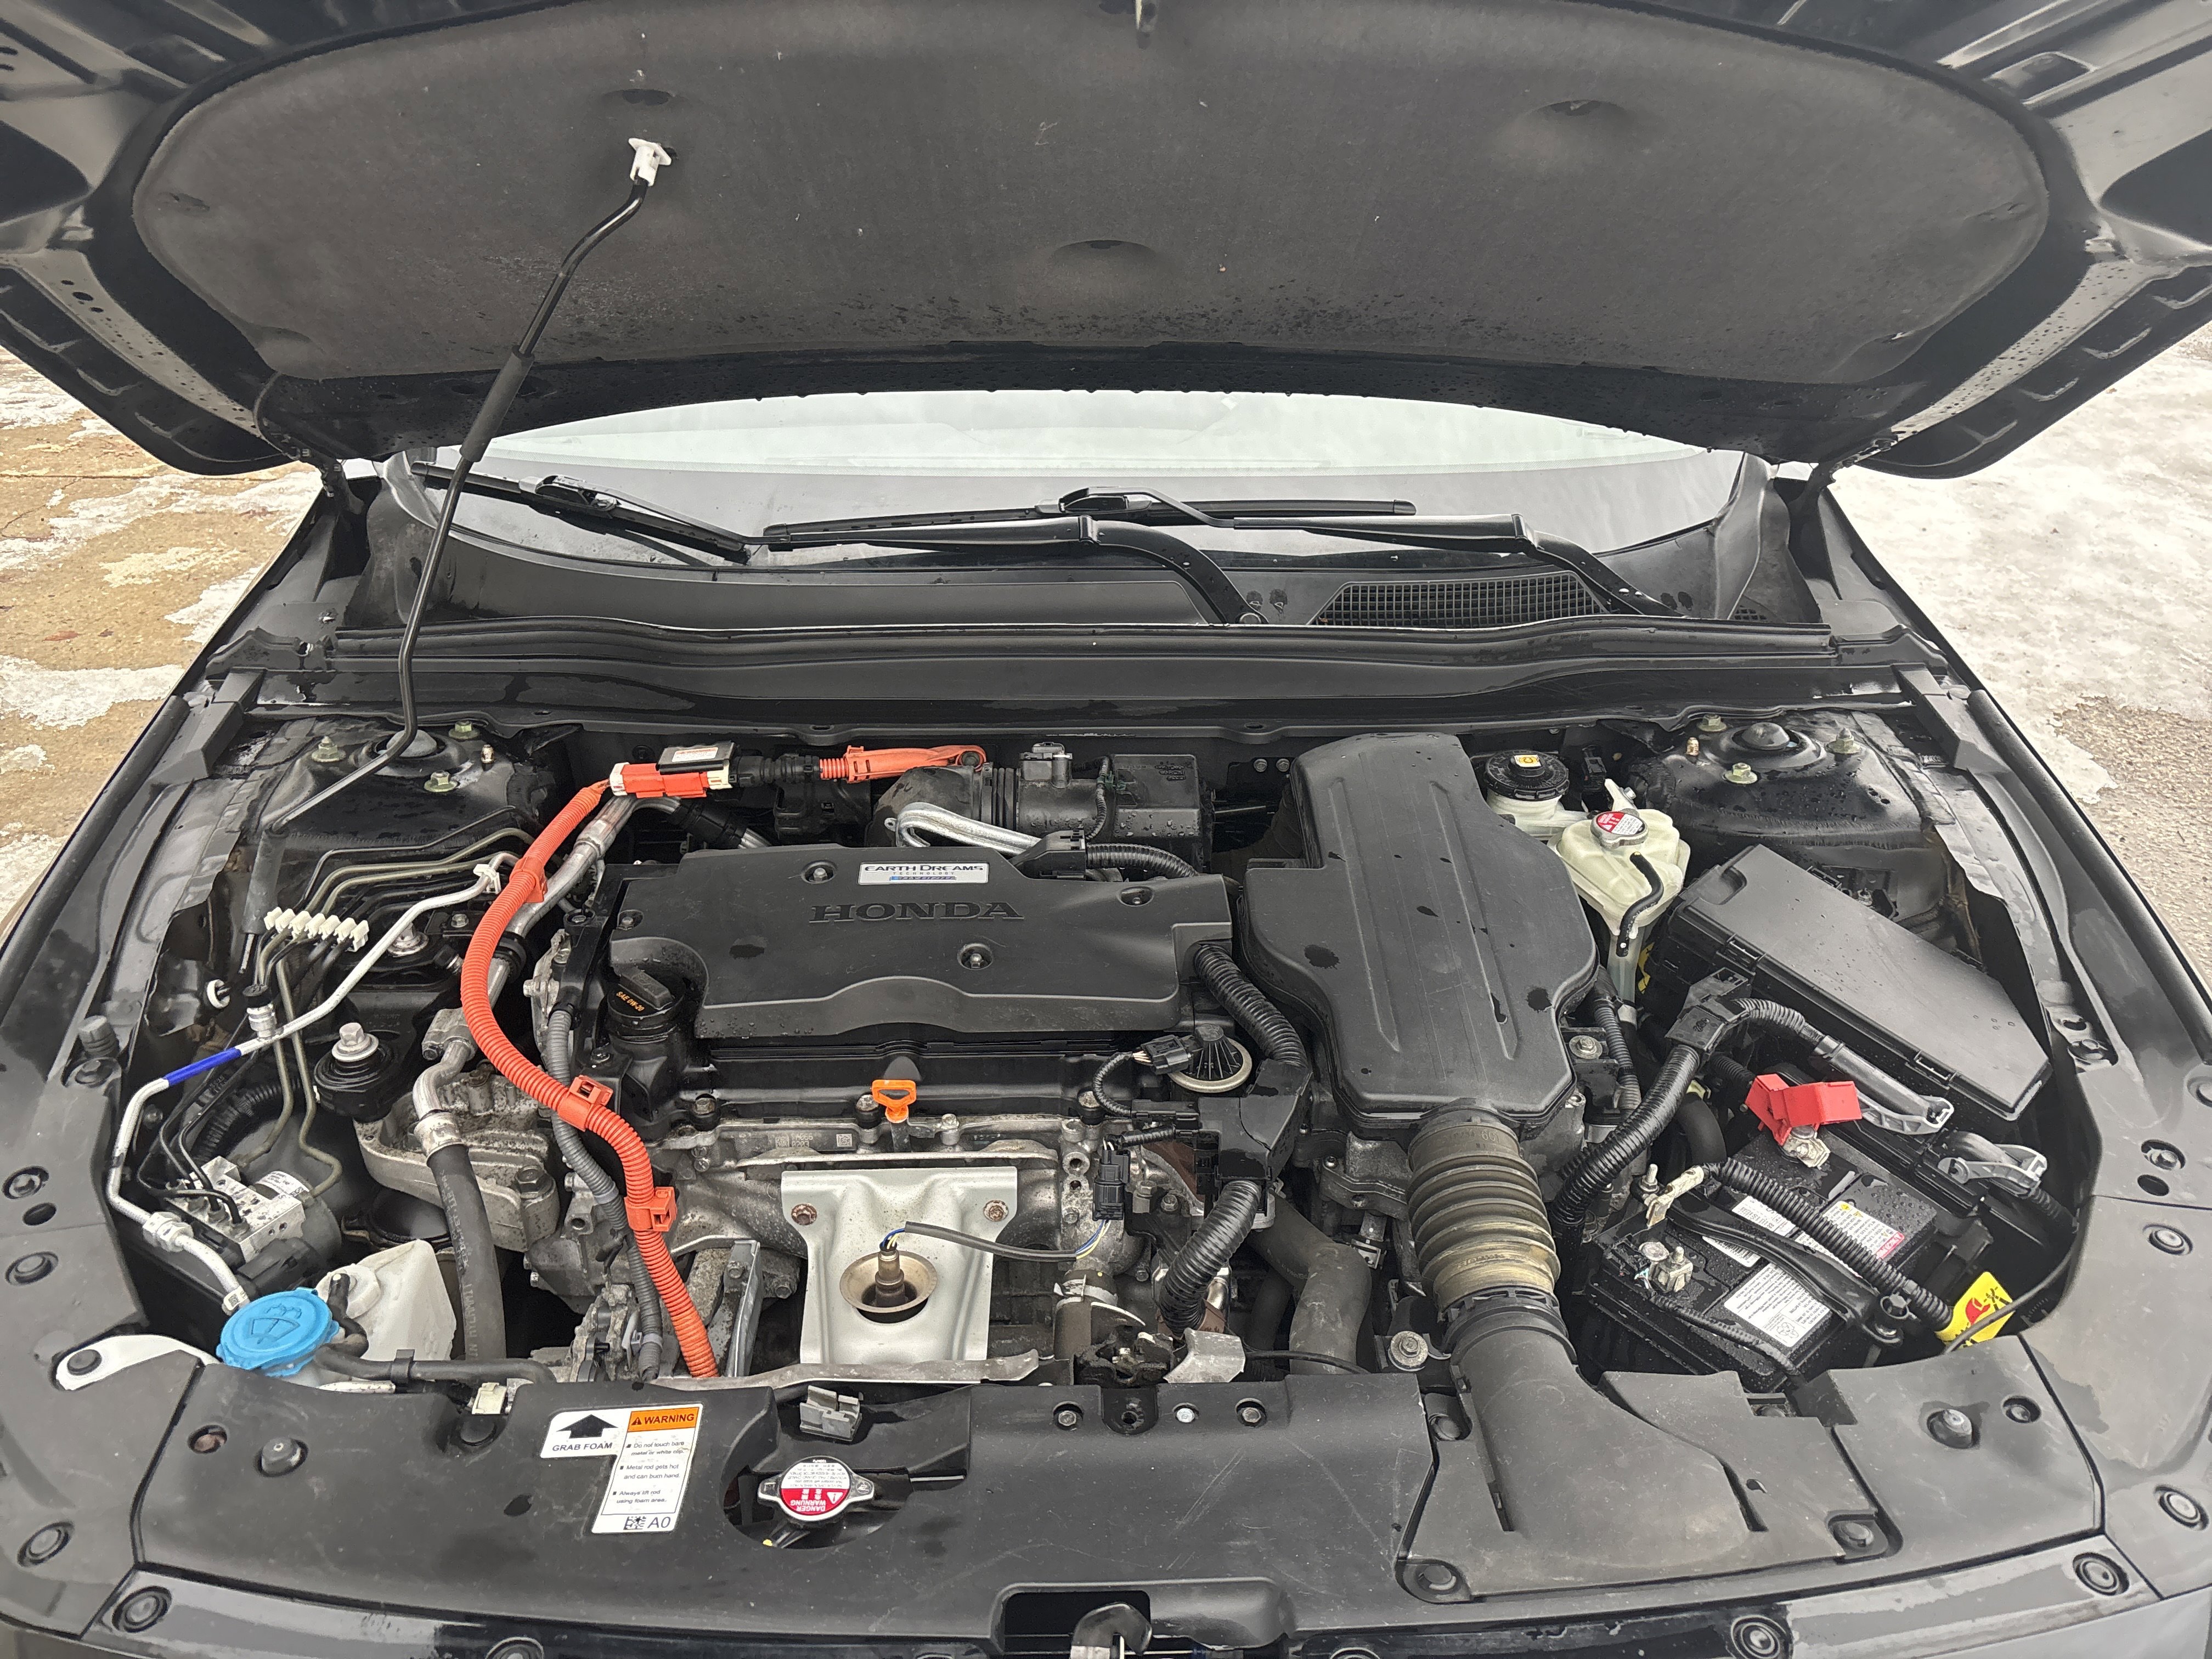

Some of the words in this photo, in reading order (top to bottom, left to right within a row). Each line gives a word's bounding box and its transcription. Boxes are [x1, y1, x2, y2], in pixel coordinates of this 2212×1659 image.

[809, 901, 1025, 923] HONDA
[616, 991, 630, 1001] SAE
[627, 998, 645, 1012] 0W-20
[644, 1413, 695, 1425] WARNING
[552, 1443, 580, 1452] GRAB
[584, 1442, 613, 1450] FOAM
[647, 1516, 671, 1529] A0
